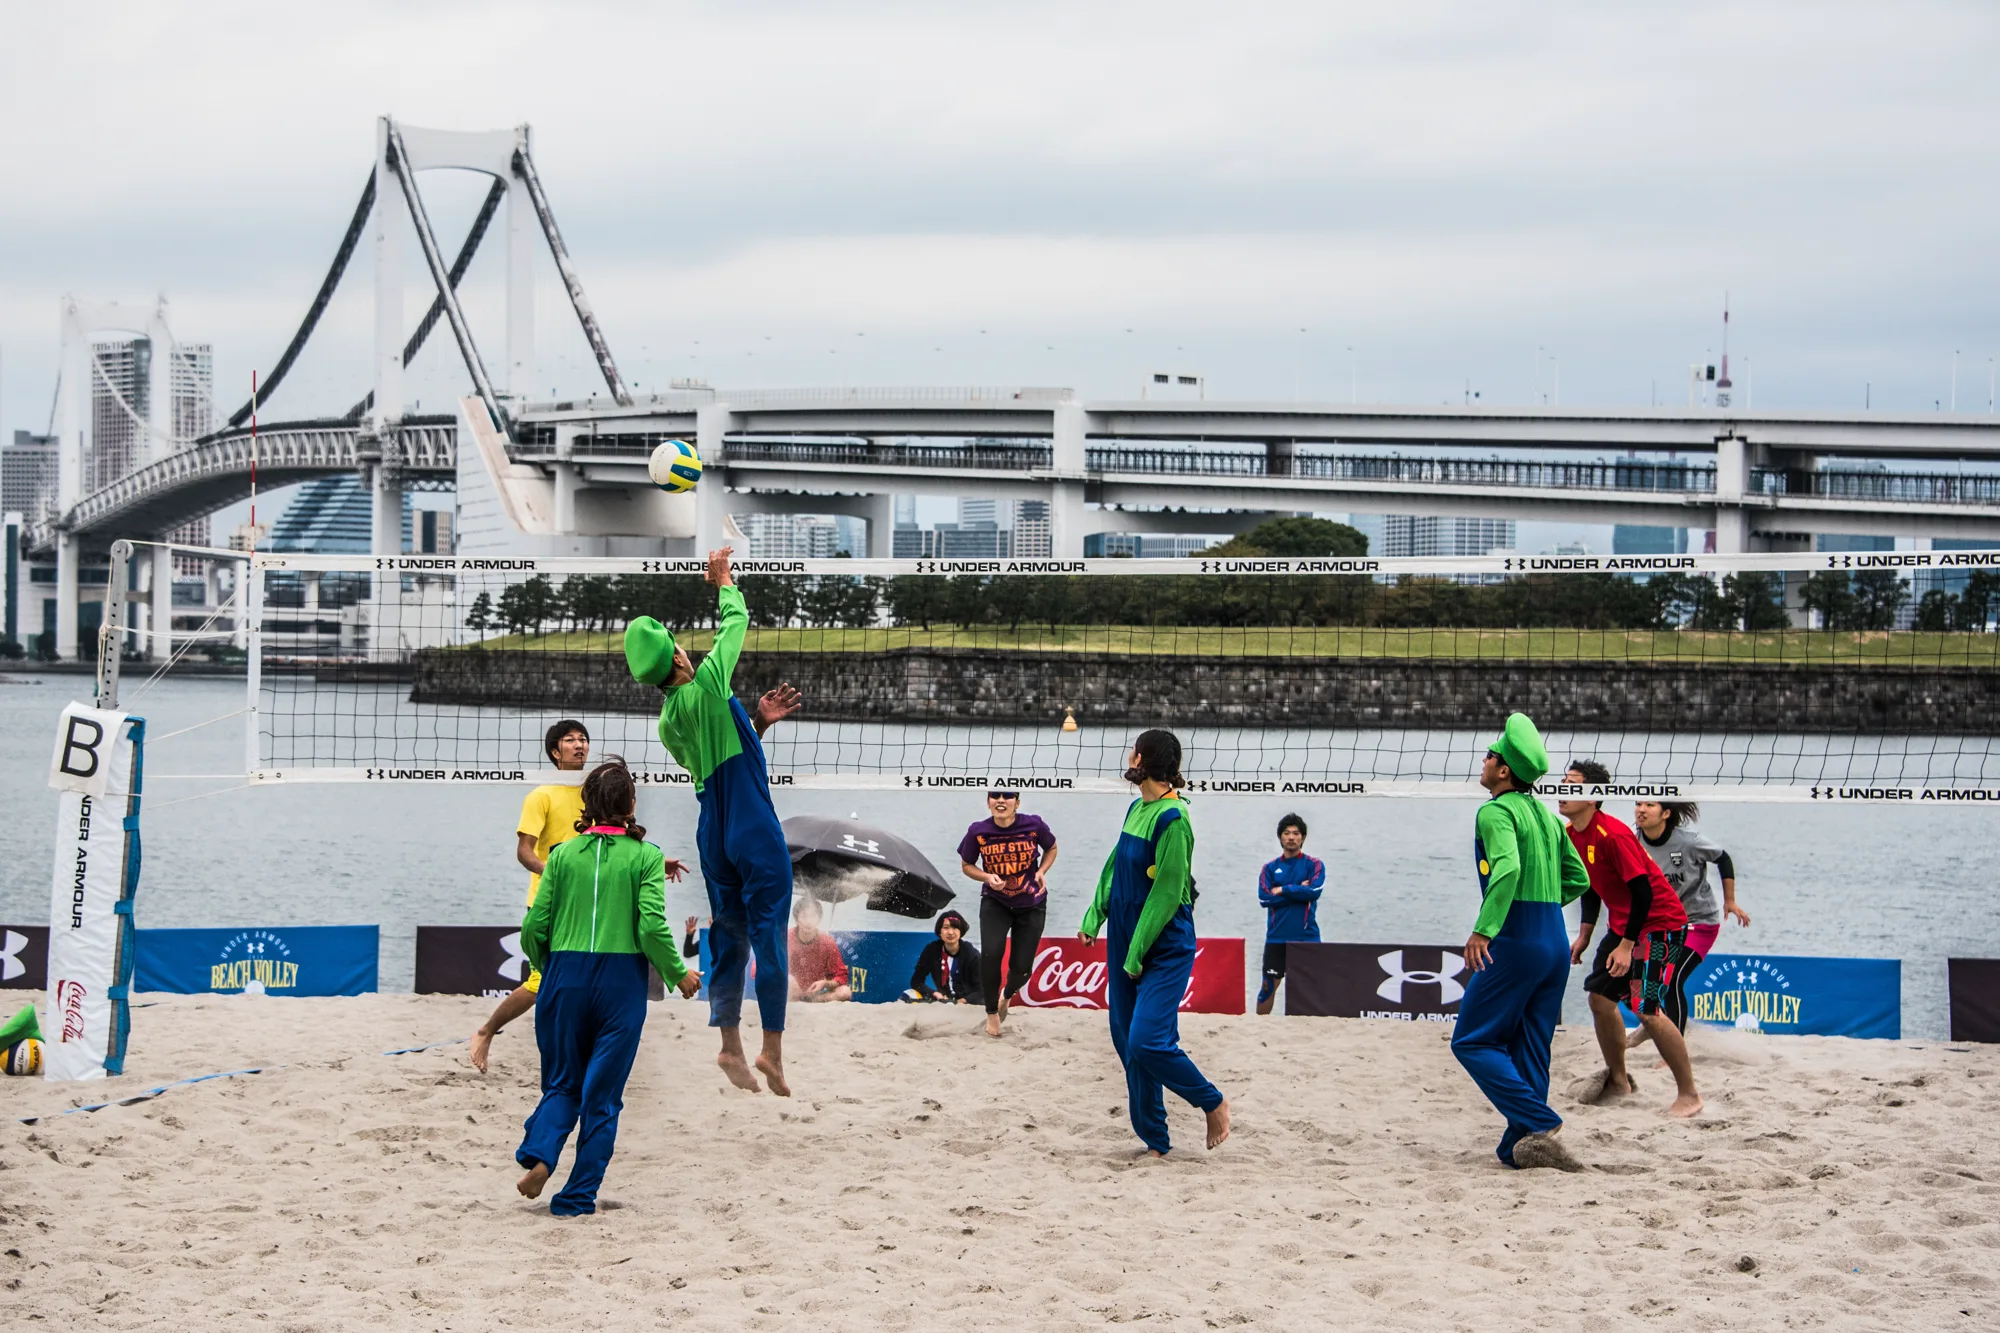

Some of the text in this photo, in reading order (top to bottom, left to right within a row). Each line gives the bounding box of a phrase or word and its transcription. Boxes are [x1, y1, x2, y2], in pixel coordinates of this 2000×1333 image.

[399, 559, 456, 569] UNDER
[1226, 561, 1290, 572] UNDER
[1531, 559, 1599, 569] UNDER
[1857, 555, 1931, 567] UNDER
[665, 562, 709, 572] UNDE
[940, 562, 1001, 572] UNDER
[60, 716, 103, 778] B
[388, 769, 446, 780] UNDER
[654, 773, 695, 783] UND
[928, 777, 988, 787] UNDER
[1212, 781, 1275, 792] UNDER
[1533, 785, 1583, 795] NDER
[1839, 788, 1913, 800] UNDER
[78, 794, 92, 841] NDER
[1008, 840, 1037, 853] STILL
[985, 850, 1034, 864] LIVES BY
[220, 930, 291, 959] UNDER ARMOUR
[211, 960, 299, 989] BEACH VOLLEY
[1704, 958, 1790, 989] UNDER ARMOUR
[482, 989, 513, 998] UND
[1694, 990, 1801, 1024] BEACH VOLLEY
[1360, 1010, 1412, 1021] UNDER
